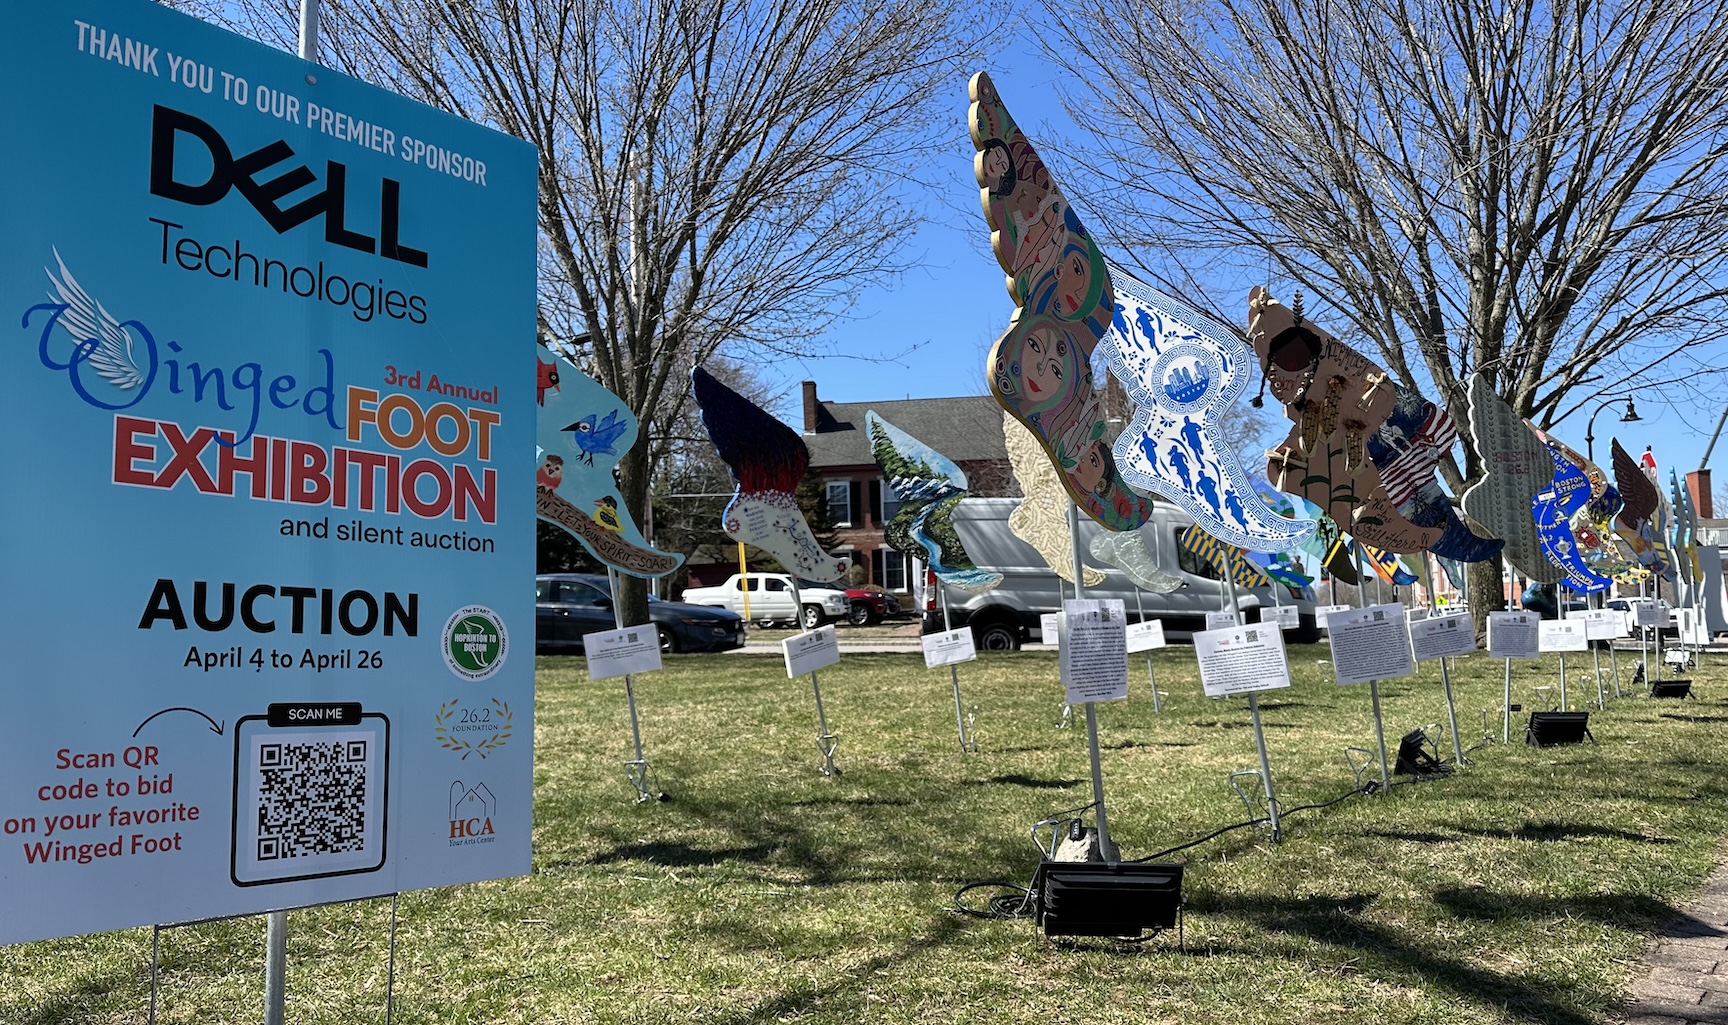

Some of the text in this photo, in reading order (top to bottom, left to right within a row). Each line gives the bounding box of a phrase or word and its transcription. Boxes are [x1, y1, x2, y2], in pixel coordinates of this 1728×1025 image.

[74, 20, 486, 186] THANK YOU TO OUR PREMIER SPONSOR
[150, 103, 428, 268] DELL
[149, 217, 427, 325] Technologies
[22, 303, 345, 447] Winged
[384, 366, 498, 405] 3rd Annual
[346, 386, 500, 461] FOOT
[112, 414, 498, 525] EXHIBITION
[1495, 451, 1538, 463] BOSTON
[1555, 476, 1583, 488] BOSTON
[1558, 481, 1587, 494] STRONG
[279, 516, 494, 553] and silent auction
[557, 511, 582, 527] LET
[582, 524, 600, 545] YOUR
[600, 541, 634, 563] SPIRIT
[637, 557, 673, 570] SOAR!
[1566, 561, 1594, 586] TRIUMPH
[138, 579, 419, 637] AUCTION
[473, 607, 490, 615] START
[454, 633, 497, 643] HOPKINTON TO
[463, 643, 487, 652] BOSTON
[184, 646, 383, 672] April 4 to April 26
[452, 664, 474, 679] something
[475, 660, 501, 678] extraordinary
[288, 707, 342, 720] SCAN ME
[460, 708, 490, 723] 26.2
[452, 724, 499, 732] FOUNDATION
[56, 746, 160, 770] Scan QR
[37, 774, 173, 801] code to bid
[3, 803, 200, 835] on your favorite
[449, 817, 495, 839] HCA
[24, 832, 182, 867] Winged Foot
[449, 837, 495, 847] Your Arts Center
